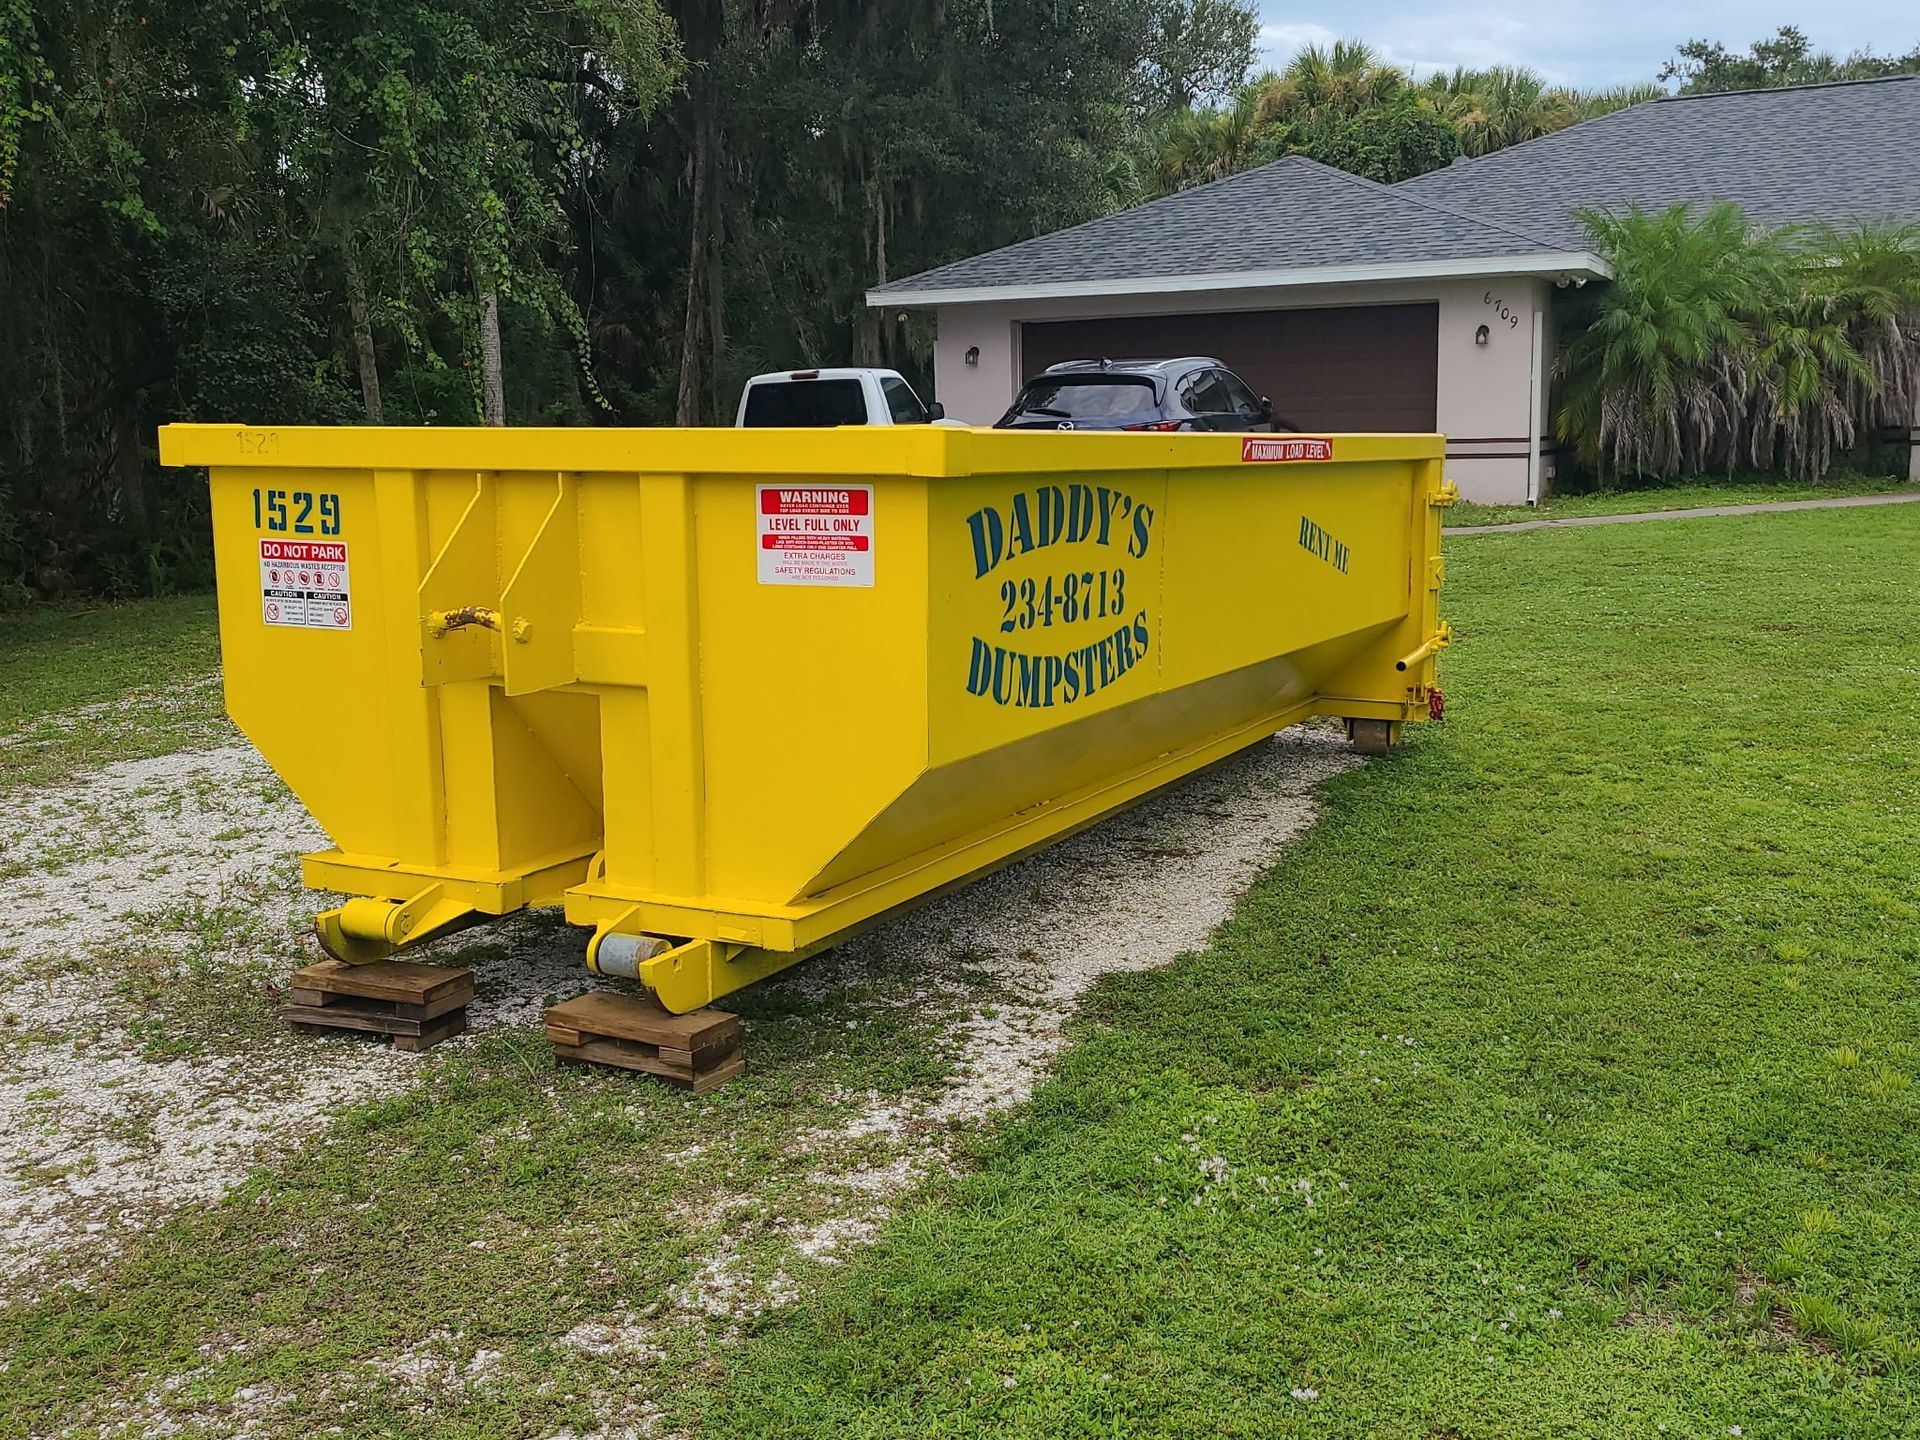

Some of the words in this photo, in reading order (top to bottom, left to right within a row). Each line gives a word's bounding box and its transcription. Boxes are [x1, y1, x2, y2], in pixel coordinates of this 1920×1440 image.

[1484, 292, 1518, 330] 6709
[1252, 444, 1283, 460] MAXIMUM
[1286, 444, 1304, 459] LOAD
[1306, 444, 1325, 459] LEVEL
[780, 492, 849, 503] WARNING
[253, 489, 340, 535] 1529
[769, 518, 800, 530] LEVEL
[805, 519, 830, 531] FULL
[833, 519, 860, 532] ONLY
[966, 484, 1154, 580] DADDY'S
[264, 544, 281, 557] DO
[284, 545, 308, 558] NOT
[312, 546, 344, 560] PARK
[1299, 516, 1333, 562] RENT
[1333, 540, 1350, 575] ME
[810, 553, 846, 561] CHARGES
[805, 568, 856, 576] REGULATIONS
[270, 590, 298, 598] CAUTION
[1001, 569, 1125, 633] 234-8713
[966, 609, 1149, 708] DUMPSTERS
